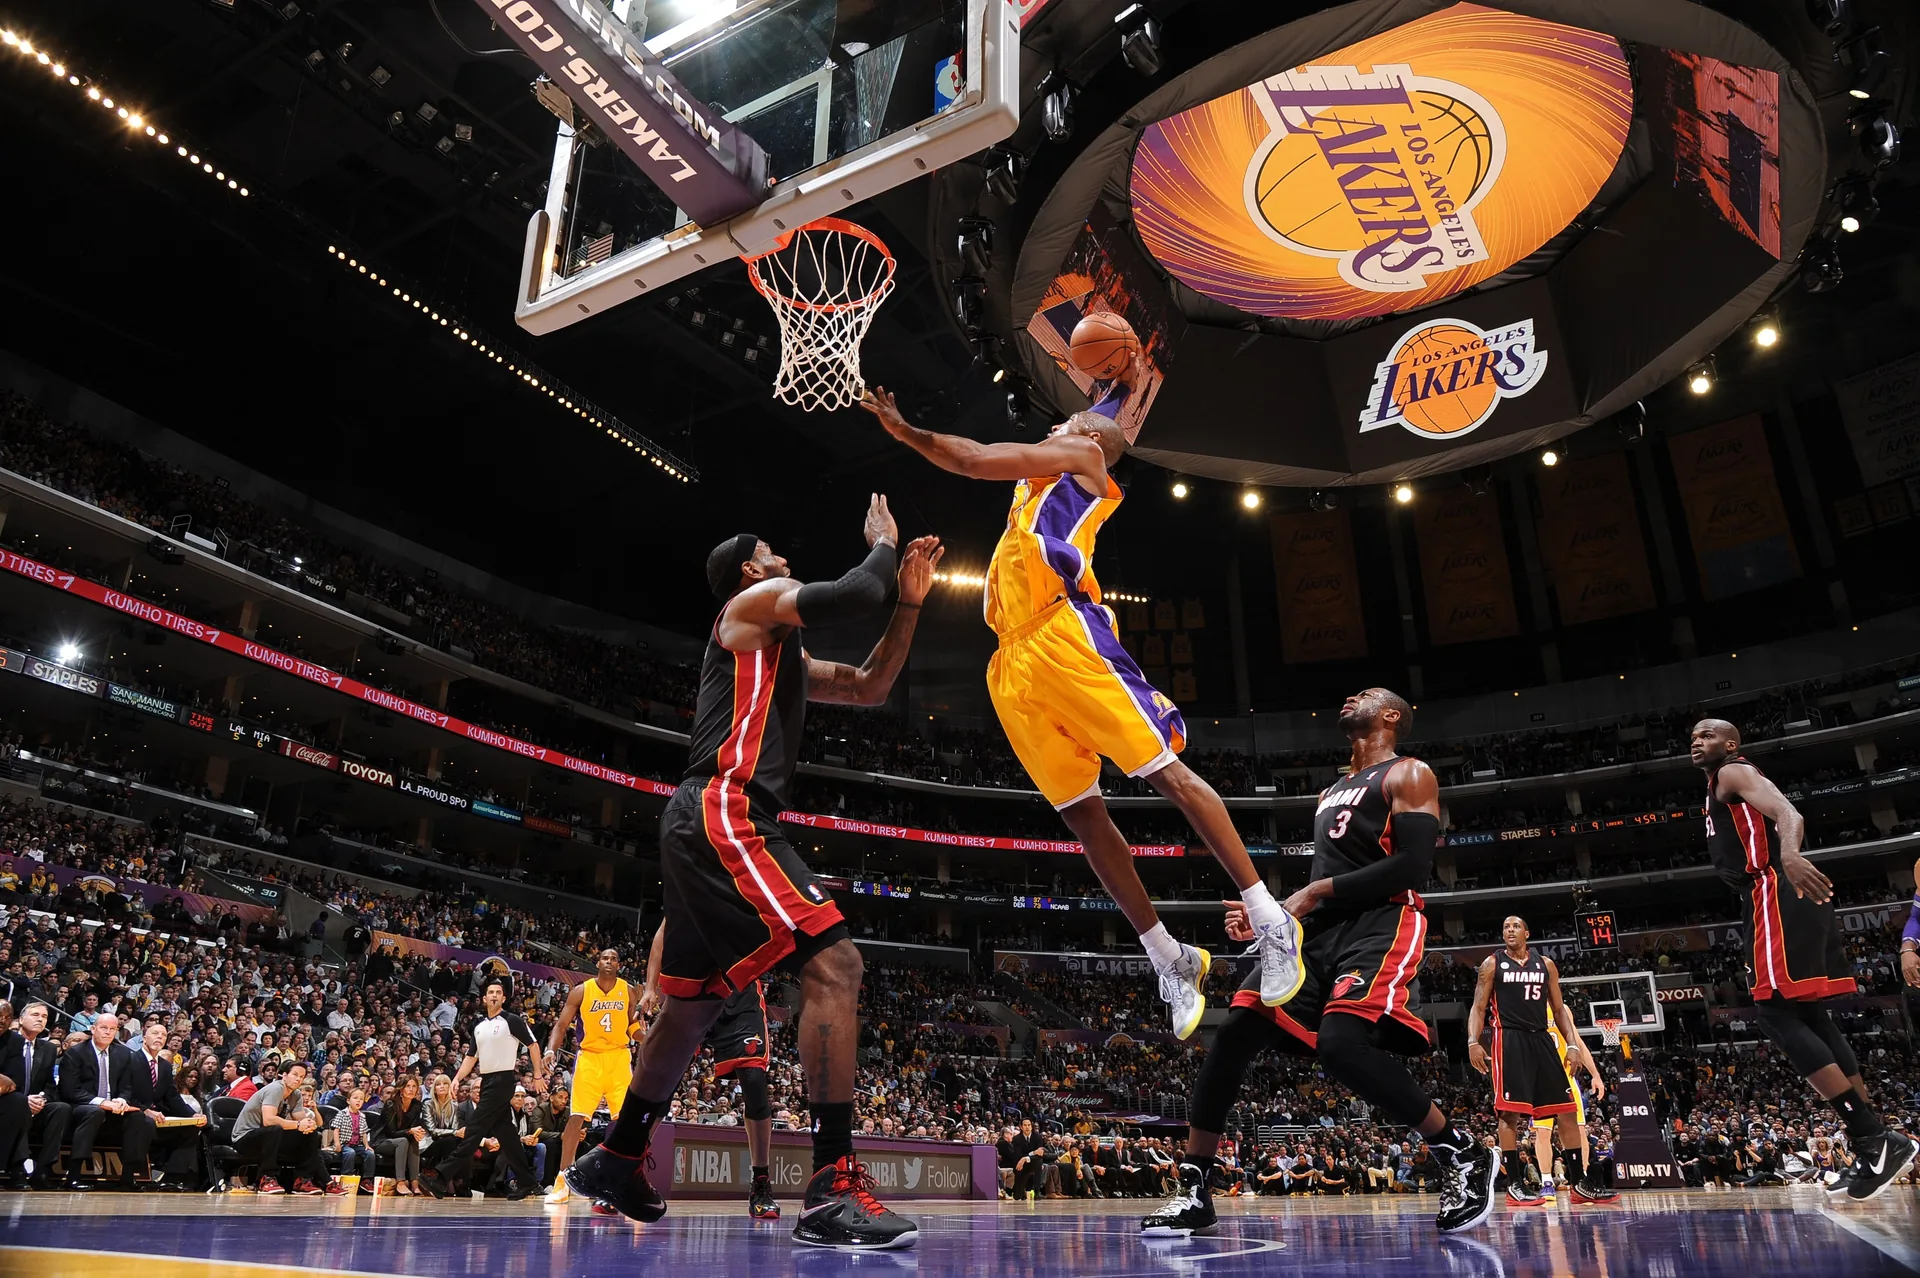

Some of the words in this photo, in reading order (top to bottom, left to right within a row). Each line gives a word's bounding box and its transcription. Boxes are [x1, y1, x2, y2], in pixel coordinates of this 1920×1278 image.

[491, 0, 697, 183] LAKERS.CO
[1261, 67, 1444, 286] LAKERS
[1399, 122, 1436, 166] LOS
[1420, 168, 1475, 259] ANGELES
[1411, 350, 1443, 368] LOS
[1445, 326, 1527, 359] ANGELES
[1368, 341, 1540, 425] LAKERS
[8, 553, 56, 584] TIRES
[103, 589, 162, 623] KUMHO
[164, 611, 205, 639] TIRES
[244, 642, 295, 671] KUMHO
[295, 660, 330, 685] TIRES
[32, 662, 99, 694] STAPLES
[110, 686, 134, 701] SAN
[137, 694, 177, 715] MANUEL
[363, 687, 407, 712] KUMHO
[408, 703, 437, 724] TIRES
[188, 719, 213, 732] OUTS
[190, 711, 215, 725] TIME
[229, 722, 246, 736] LAL
[253, 730, 271, 743] MIA
[466, 725, 506, 748] KUMHO
[507, 738, 536, 757] TIRES
[257, 739, 264, 748] 6
[342, 759, 394, 787] TOYOTA
[563, 756, 601, 777] KUMHO
[602, 768, 627, 785] TIRES
[1870, 775, 1906, 786] Panasonic
[653, 783, 679, 797] KUM
[472, 803, 499, 817] American
[499, 810, 522, 822] Express
[781, 811, 806, 825] TIRES
[834, 819, 870, 835] KUMHO
[871, 823, 898, 838] TIRES
[1328, 809, 1353, 840] 3
[923, 831, 958, 846] KUMHO
[959, 835, 985, 848] TIRES
[1460, 834, 1494, 845] DELTA
[1501, 828, 1541, 841] STAPLES
[1013, 840, 1049, 852] KUMHO
[1049, 842, 1075, 853] TIRES
[1138, 846, 1165, 857] TIRES
[260, 888, 278, 898] 3D
[919, 890, 946, 900] Panasonic
[1089, 901, 1121, 911] DELTA
[1586, 915, 1612, 927] 4:59
[380, 937, 395, 947] 102
[1591, 927, 1613, 946] 14
[1502, 971, 1545, 984] MIAMI
[1523, 984, 1542, 1001] 15
[589, 999, 625, 1013] LAKERS
[599, 1012, 613, 1033] 4
[1622, 1105, 1649, 1117] BIG
[691, 1149, 732, 1184] NBA
[770, 1156, 803, 1186] ike
[928, 1165, 969, 1190] Follow
[1629, 1164, 1652, 1178] NBA
[1652, 1163, 1672, 1177] TV
